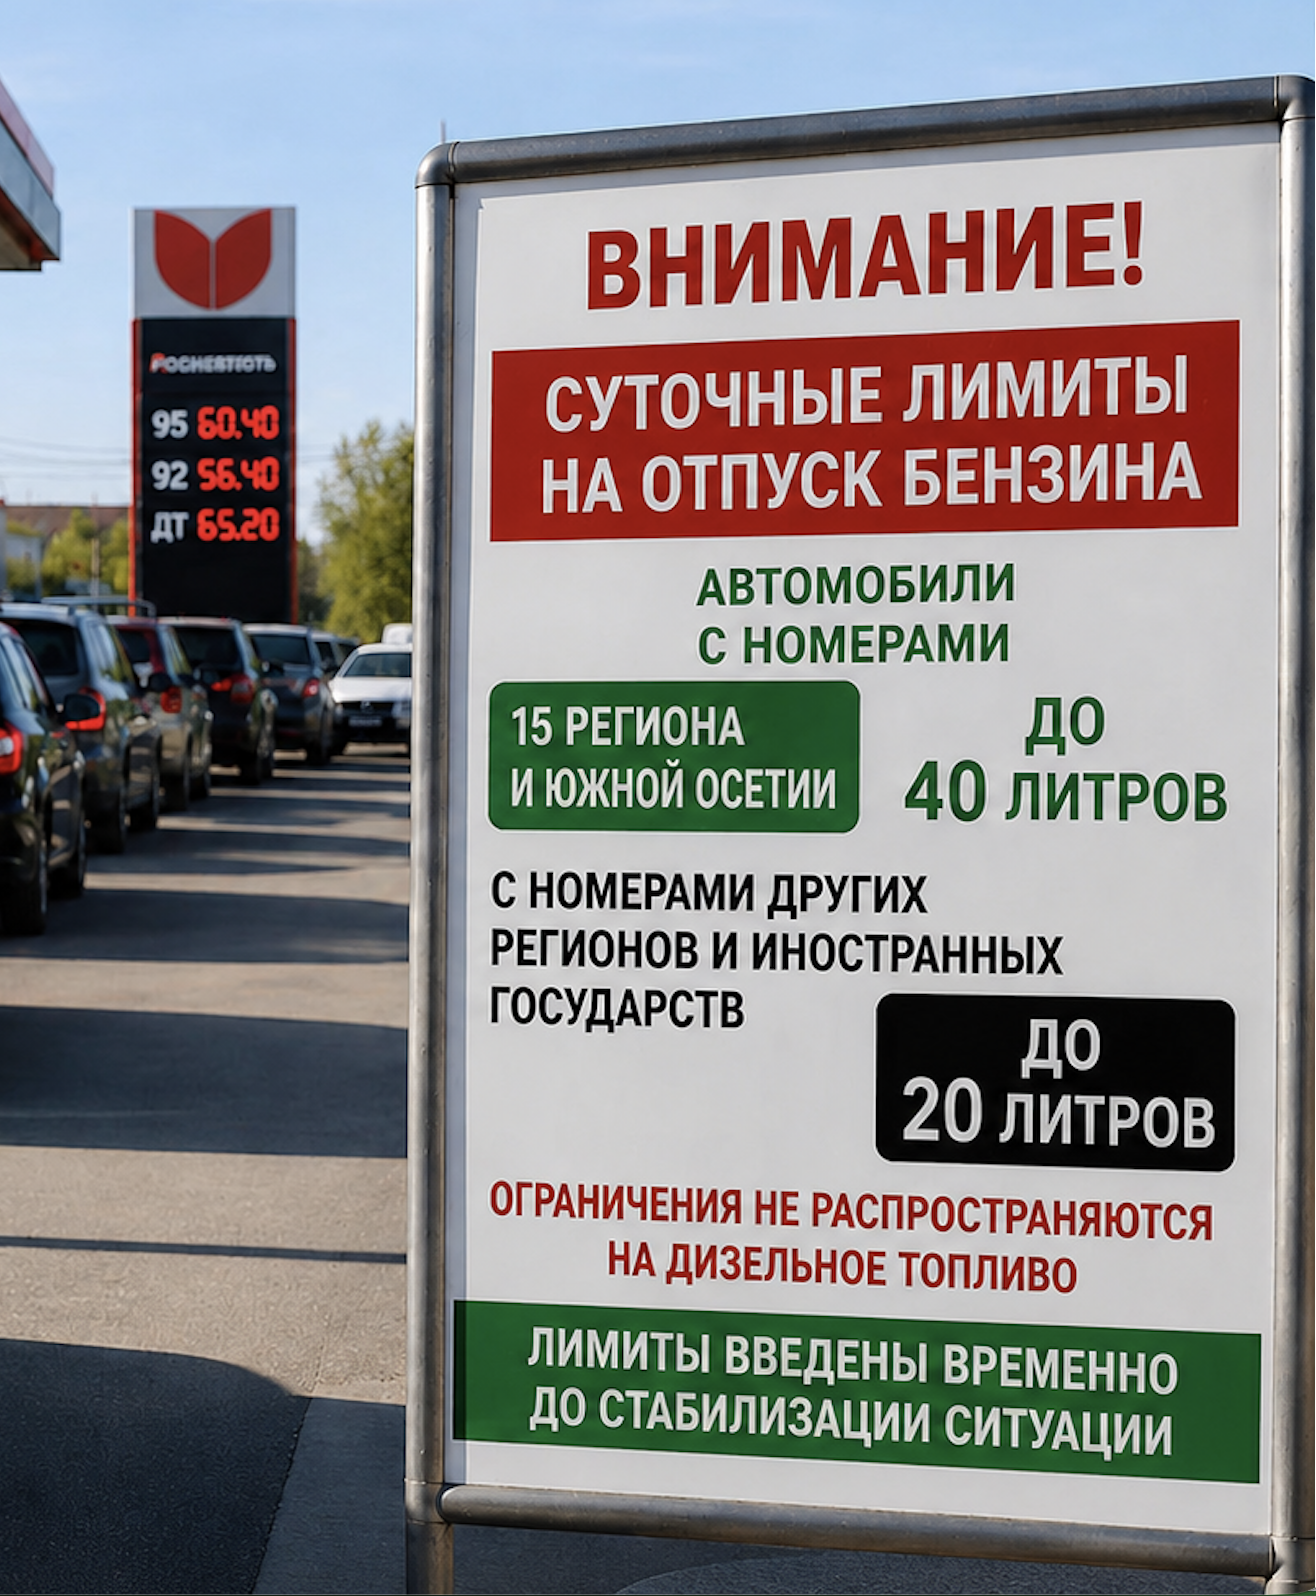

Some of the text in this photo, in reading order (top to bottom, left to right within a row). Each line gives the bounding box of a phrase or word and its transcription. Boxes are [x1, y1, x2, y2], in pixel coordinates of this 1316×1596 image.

[586, 199, 1144, 311] ВНИМАНИЕ!
[545, 353, 1189, 434] СУТОЧНЫЕ ЛИМИТЫ
[151, 405, 280, 440] 95 60.40
[151, 456, 280, 491] 92 56.40
[541, 440, 1204, 515] НА ОТПУСК БЕНЗИНА
[150, 507, 280, 543] ДТ 65.20
[694, 562, 1017, 608] АВТОМОБИЛИ
[697, 622, 1010, 666] С НОМЕРАМИ
[510, 704, 747, 747] 15 РЕГИОНА
[1024, 694, 1106, 758] ДО
[510, 757, 837, 811] И ЮЖНОЙ ОСЕТИИ
[903, 758, 1229, 823] 40 ЛИТРОВ
[490, 869, 929, 921] С НОМЕРАМИ ДРУГИХ
[490, 927, 1065, 976] РЕГИОНОВ И ИНОСТРАННЫХ
[490, 985, 746, 1035] ГОСУДАРСТВ
[1020, 1017, 1102, 1081] ДО
[902, 1074, 1217, 1149] 20 ЛИТРОВ
[489, 1179, 1214, 1242] ОГРАНИЧЕНИЯ НЕ РАСПРОСТРАНЯЮТСЯ
[607, 1239, 1078, 1295] НА ДИЗЕЛЬНОЕ ТОПЛИВО
[526, 1325, 1179, 1396] ЛИМИТЫ ВВЕДЕНЫ ВРЕМЕННО
[528, 1385, 1173, 1463] ДО СТАБИЛИЗАЦИИ СИТУАЦИИ
